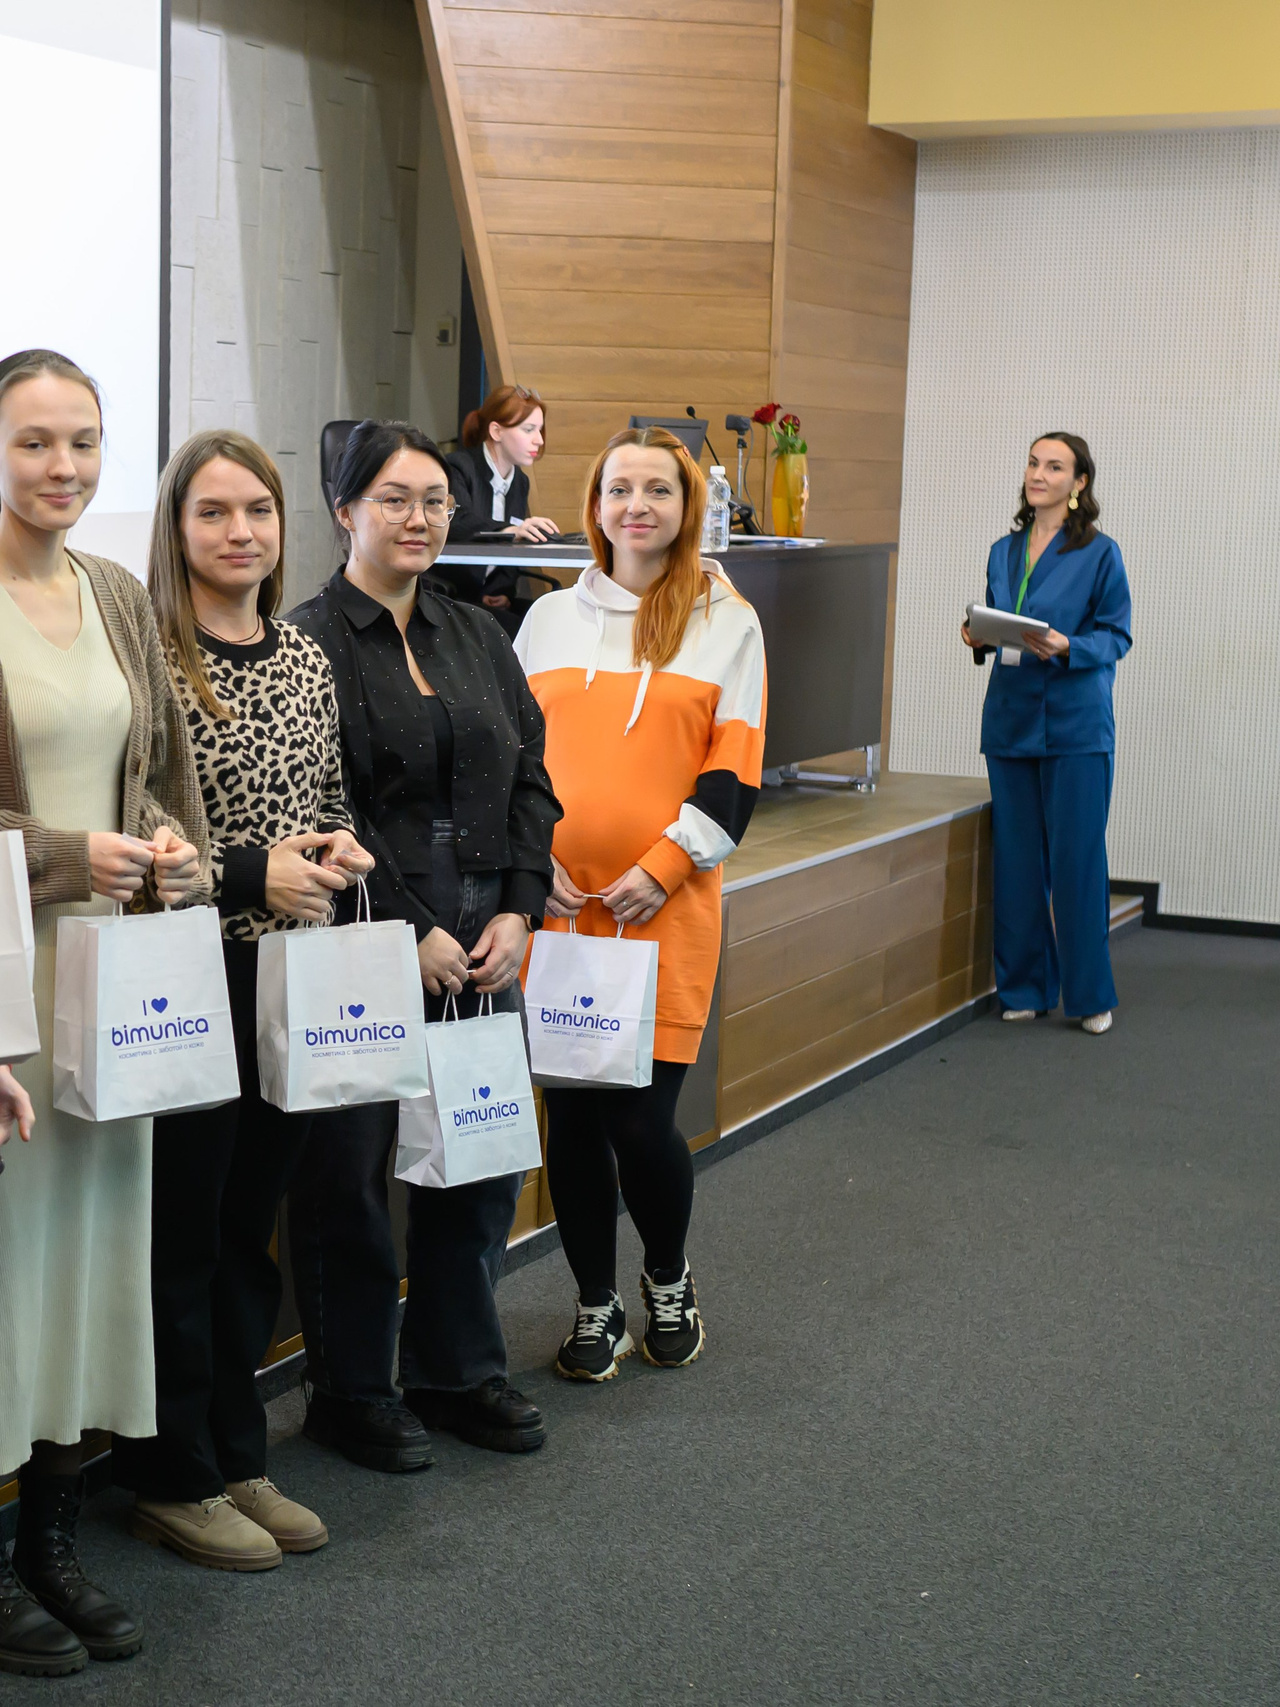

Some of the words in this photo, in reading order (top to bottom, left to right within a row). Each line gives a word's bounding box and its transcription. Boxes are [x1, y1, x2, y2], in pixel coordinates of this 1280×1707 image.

[540, 1007, 621, 1031] bimunica
[112, 1016, 209, 1047] bimunica
[305, 1022, 406, 1046] bimunica
[118, 1049, 152, 1060] косметика
[159, 1045, 183, 1054] заботой
[188, 1041, 205, 1049] коже
[311, 1050, 346, 1058] косметика
[352, 1046, 377, 1055] заботой
[453, 1101, 520, 1127] bimunica
